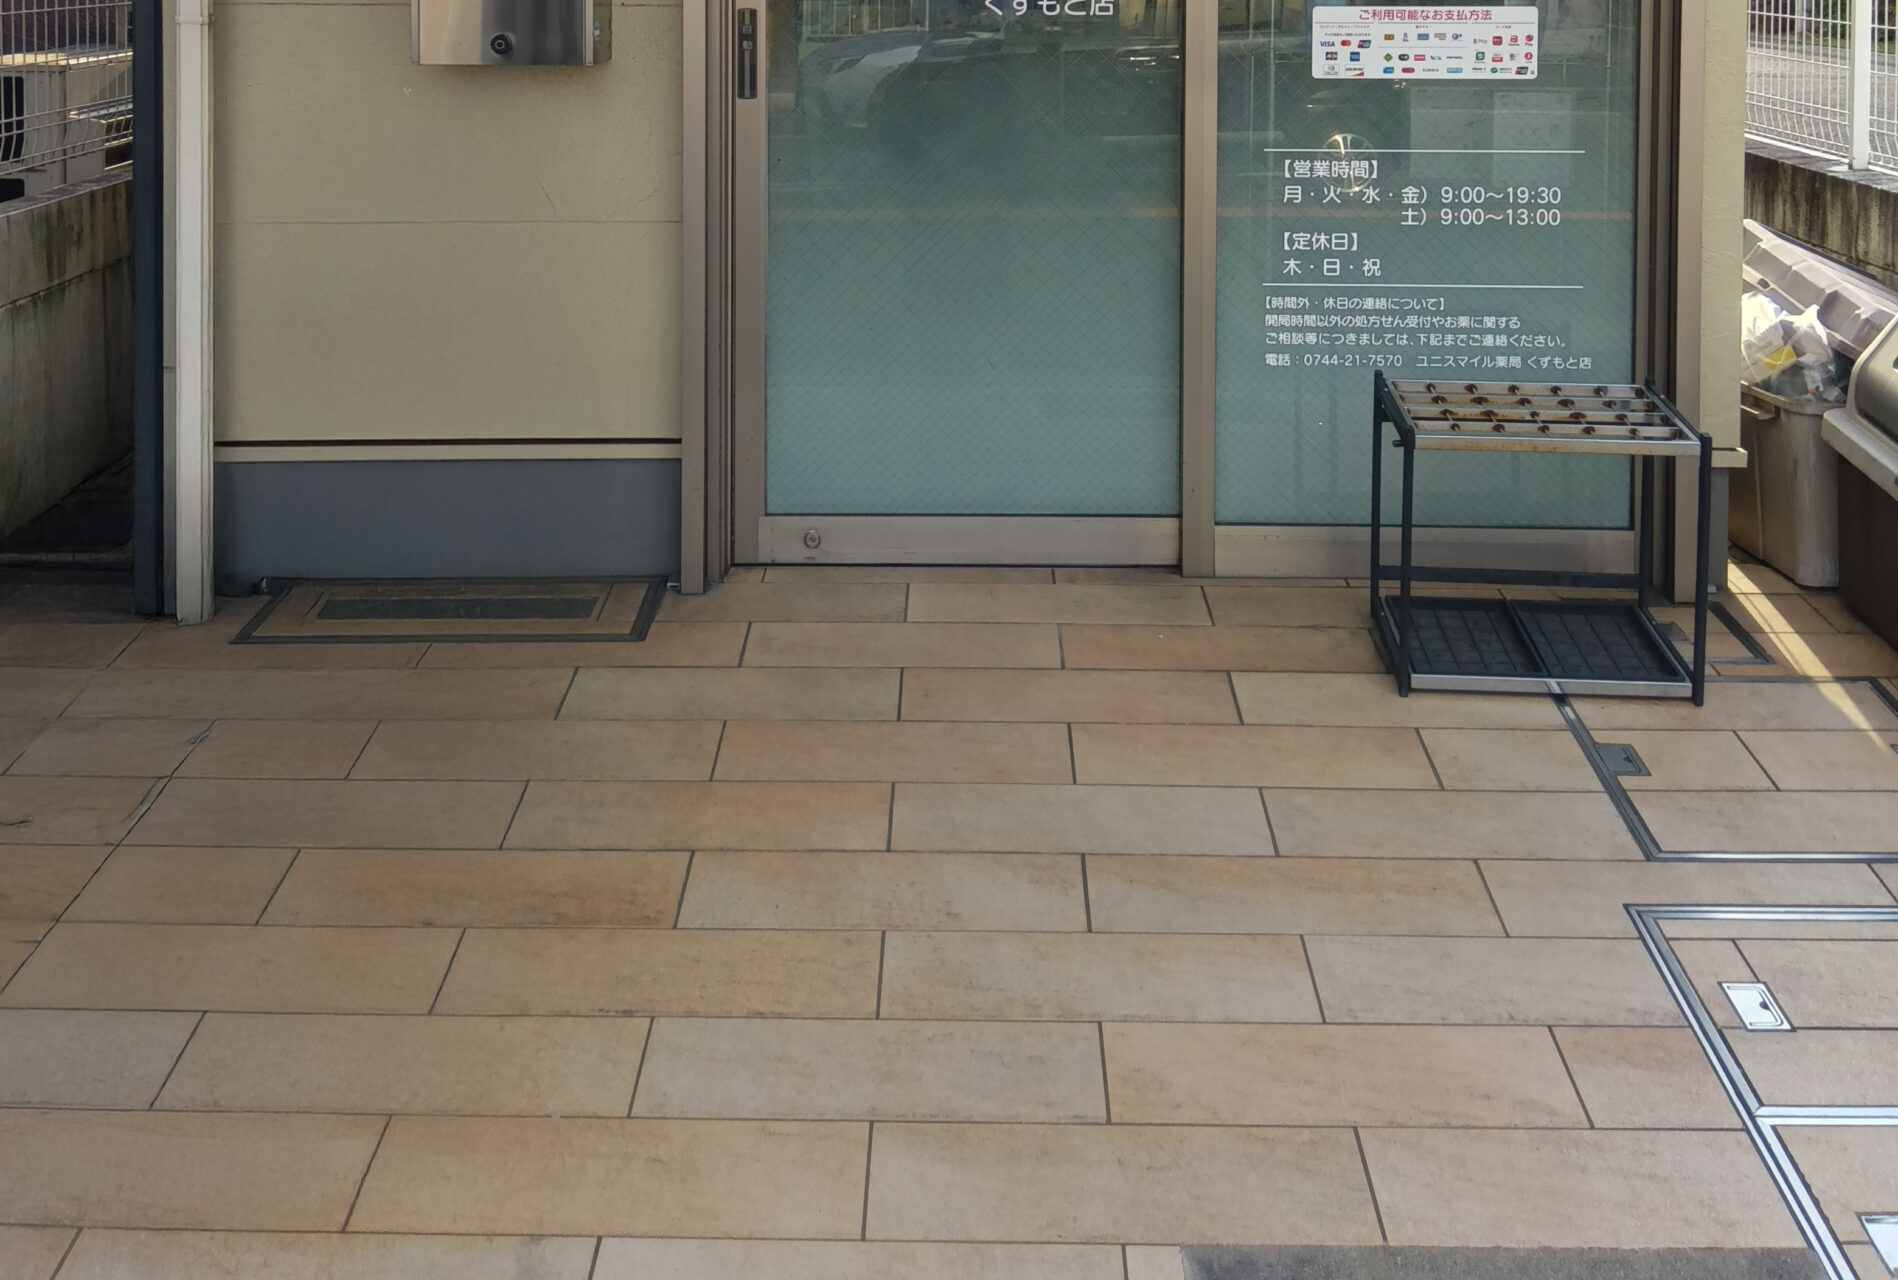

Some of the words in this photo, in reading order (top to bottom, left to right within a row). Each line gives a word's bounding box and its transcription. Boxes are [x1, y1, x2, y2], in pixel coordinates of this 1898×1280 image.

[1359, 9, 1493, 21] ご利用可能なお支払方法
[1284, 159, 1378, 179] 【営業時間】
[1441, 187, 1561, 204] 9:00～19:30
[1441, 209, 1561, 226] 9:00～13:00
[1283, 232, 1358, 251] 【定休日】
[1283, 258, 1381, 276] 木・日・祝
[1265, 297, 1444, 310] 【時間外・休日の連絡について】
[1265, 315, 1521, 329] 開局時間以外の処方せん受付やお薬に関する
[1416, 355, 1522, 369] ユニスマイル薬局
[1527, 356, 1592, 370] くずもと店
